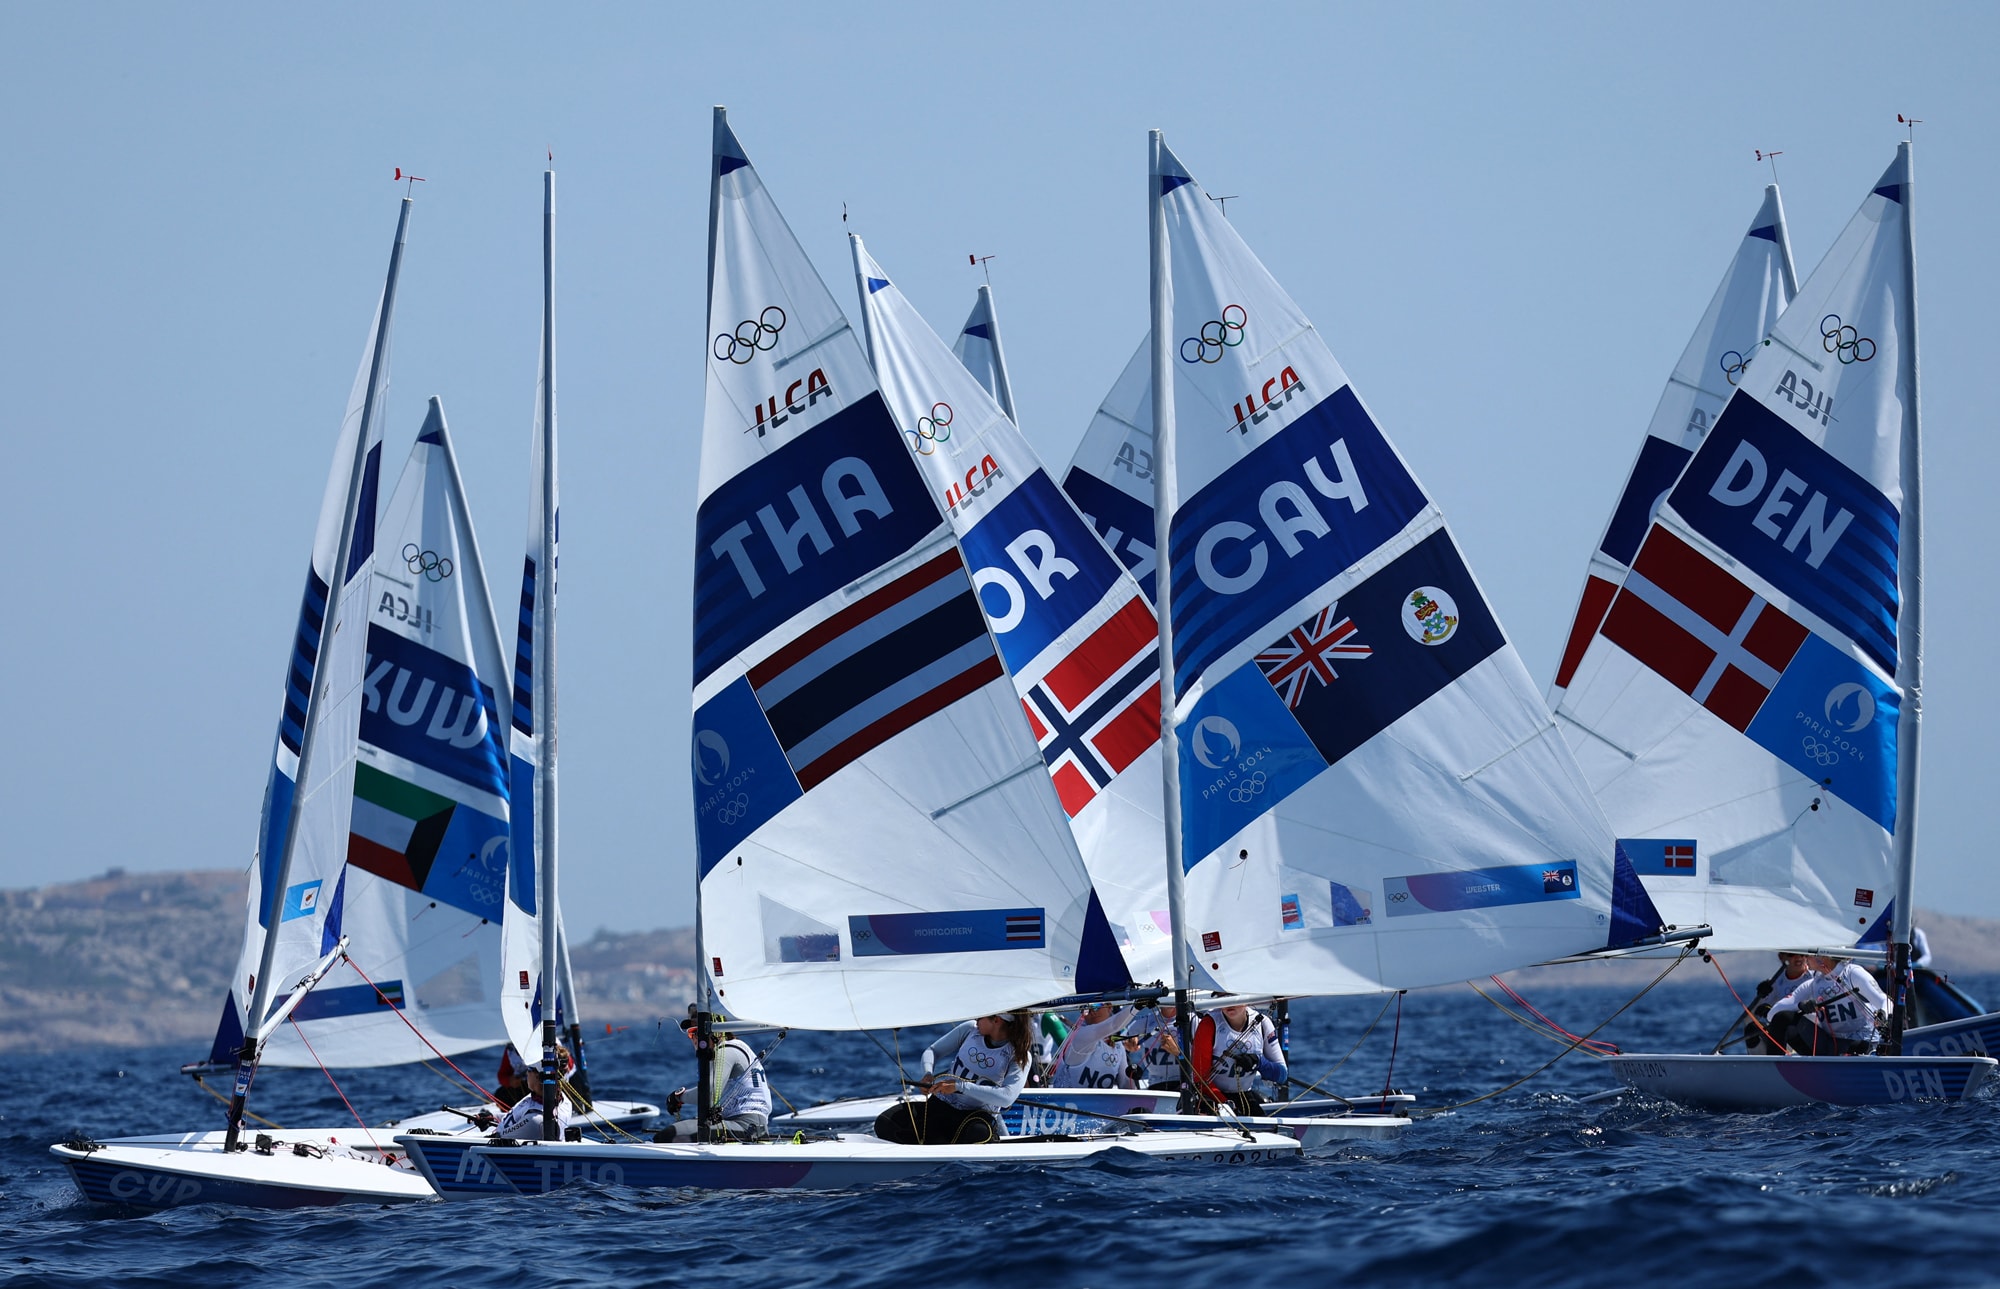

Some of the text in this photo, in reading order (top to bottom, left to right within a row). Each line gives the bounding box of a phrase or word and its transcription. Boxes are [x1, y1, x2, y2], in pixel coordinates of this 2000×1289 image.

[752, 368, 833, 438] ILCA
[1229, 365, 1307, 435] ILCA
[945, 454, 1004, 519] ILCA
[1708, 439, 1855, 570] DEN
[710, 456, 894, 599] THA
[1194, 437, 1369, 595] CAY
[972, 529, 1079, 634] OR
[362, 652, 488, 749] KUW
[1795, 711, 1865, 761] PARIS 2024
[700, 767, 756, 817] PARIS 2024
[1202, 746, 1272, 800] PARIS 2024
[1465, 883, 1501, 895] WEBSTER
[914, 926, 973, 937] MONTGOMERY
[1078, 1066, 1121, 1089] NO
[1881, 1068, 1947, 1101] DEN
[502, 1117, 529, 1136] HANSEN
[109, 1169, 202, 1204] CYP
